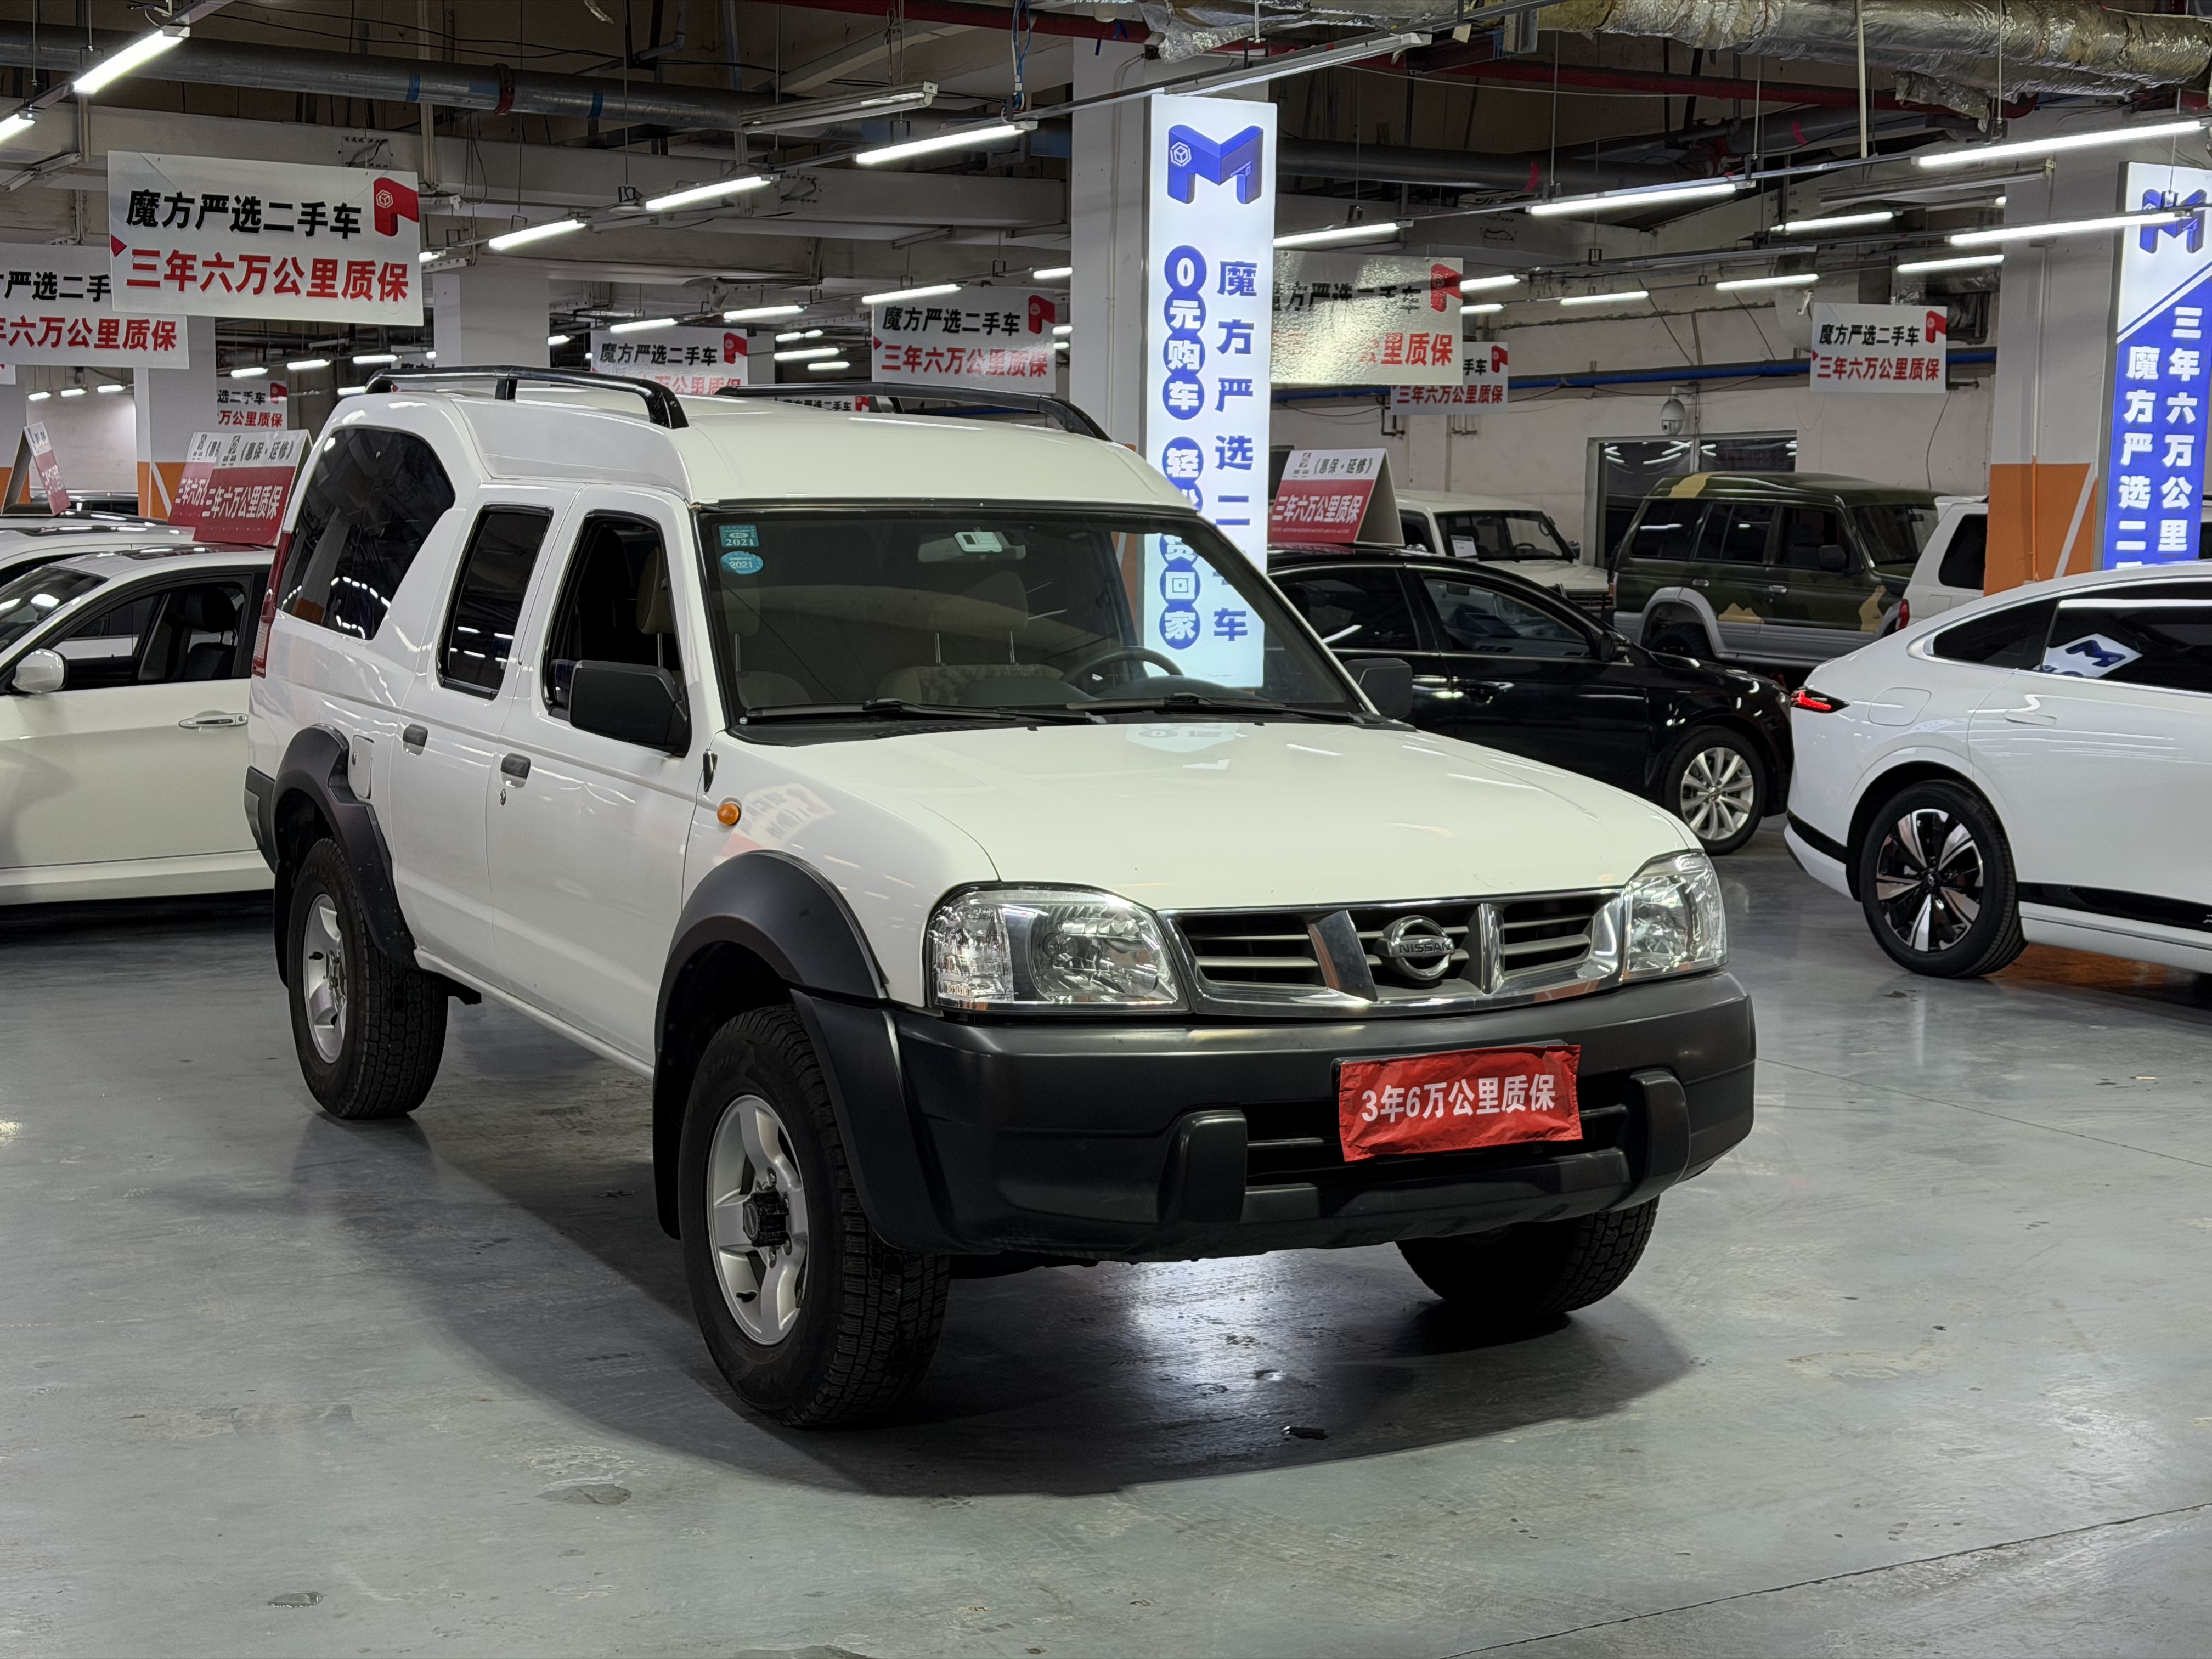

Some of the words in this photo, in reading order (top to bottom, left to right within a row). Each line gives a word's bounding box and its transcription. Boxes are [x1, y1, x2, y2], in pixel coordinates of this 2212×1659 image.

[126, 189, 362, 239] 魔方严选二手车
[0, 270, 111, 302] 严选二手
[126, 248, 409, 302] 三年六万公里质保
[0, 315, 177, 352] 六万公里质保
[882, 306, 1021, 336] 魔方严选二手车
[1819, 324, 1920, 347] 魔方严选二手车
[600, 342, 718, 366] 魔方严选二手车
[881, 344, 1048, 378] 三年六万公里质保
[1463, 358, 1487, 376] 手车
[1816, 356, 1940, 381] 三年六万公里质保
[217, 388, 266, 405] 选二手车
[1396, 385, 1503, 404] 三年六万公里质保
[218, 410, 283, 428] 万公里质保
[2158, 306, 2202, 552] 三年六万公里
[1213, 260, 1257, 642] 魔方严选二车
[2116, 346, 2160, 569] 魔方严选二
[201, 485, 284, 520] 三年六万公里质保
[1271, 494, 1364, 524] 三年六万公里质保
[725, 538, 755, 546] 2021
[1164, 448, 1200, 640] 轻贷回家
[729, 561, 753, 569] 2021
[1399, 942, 1451, 953] NISSAN
[1361, 1073, 1556, 1124] 3年6万公里质保
